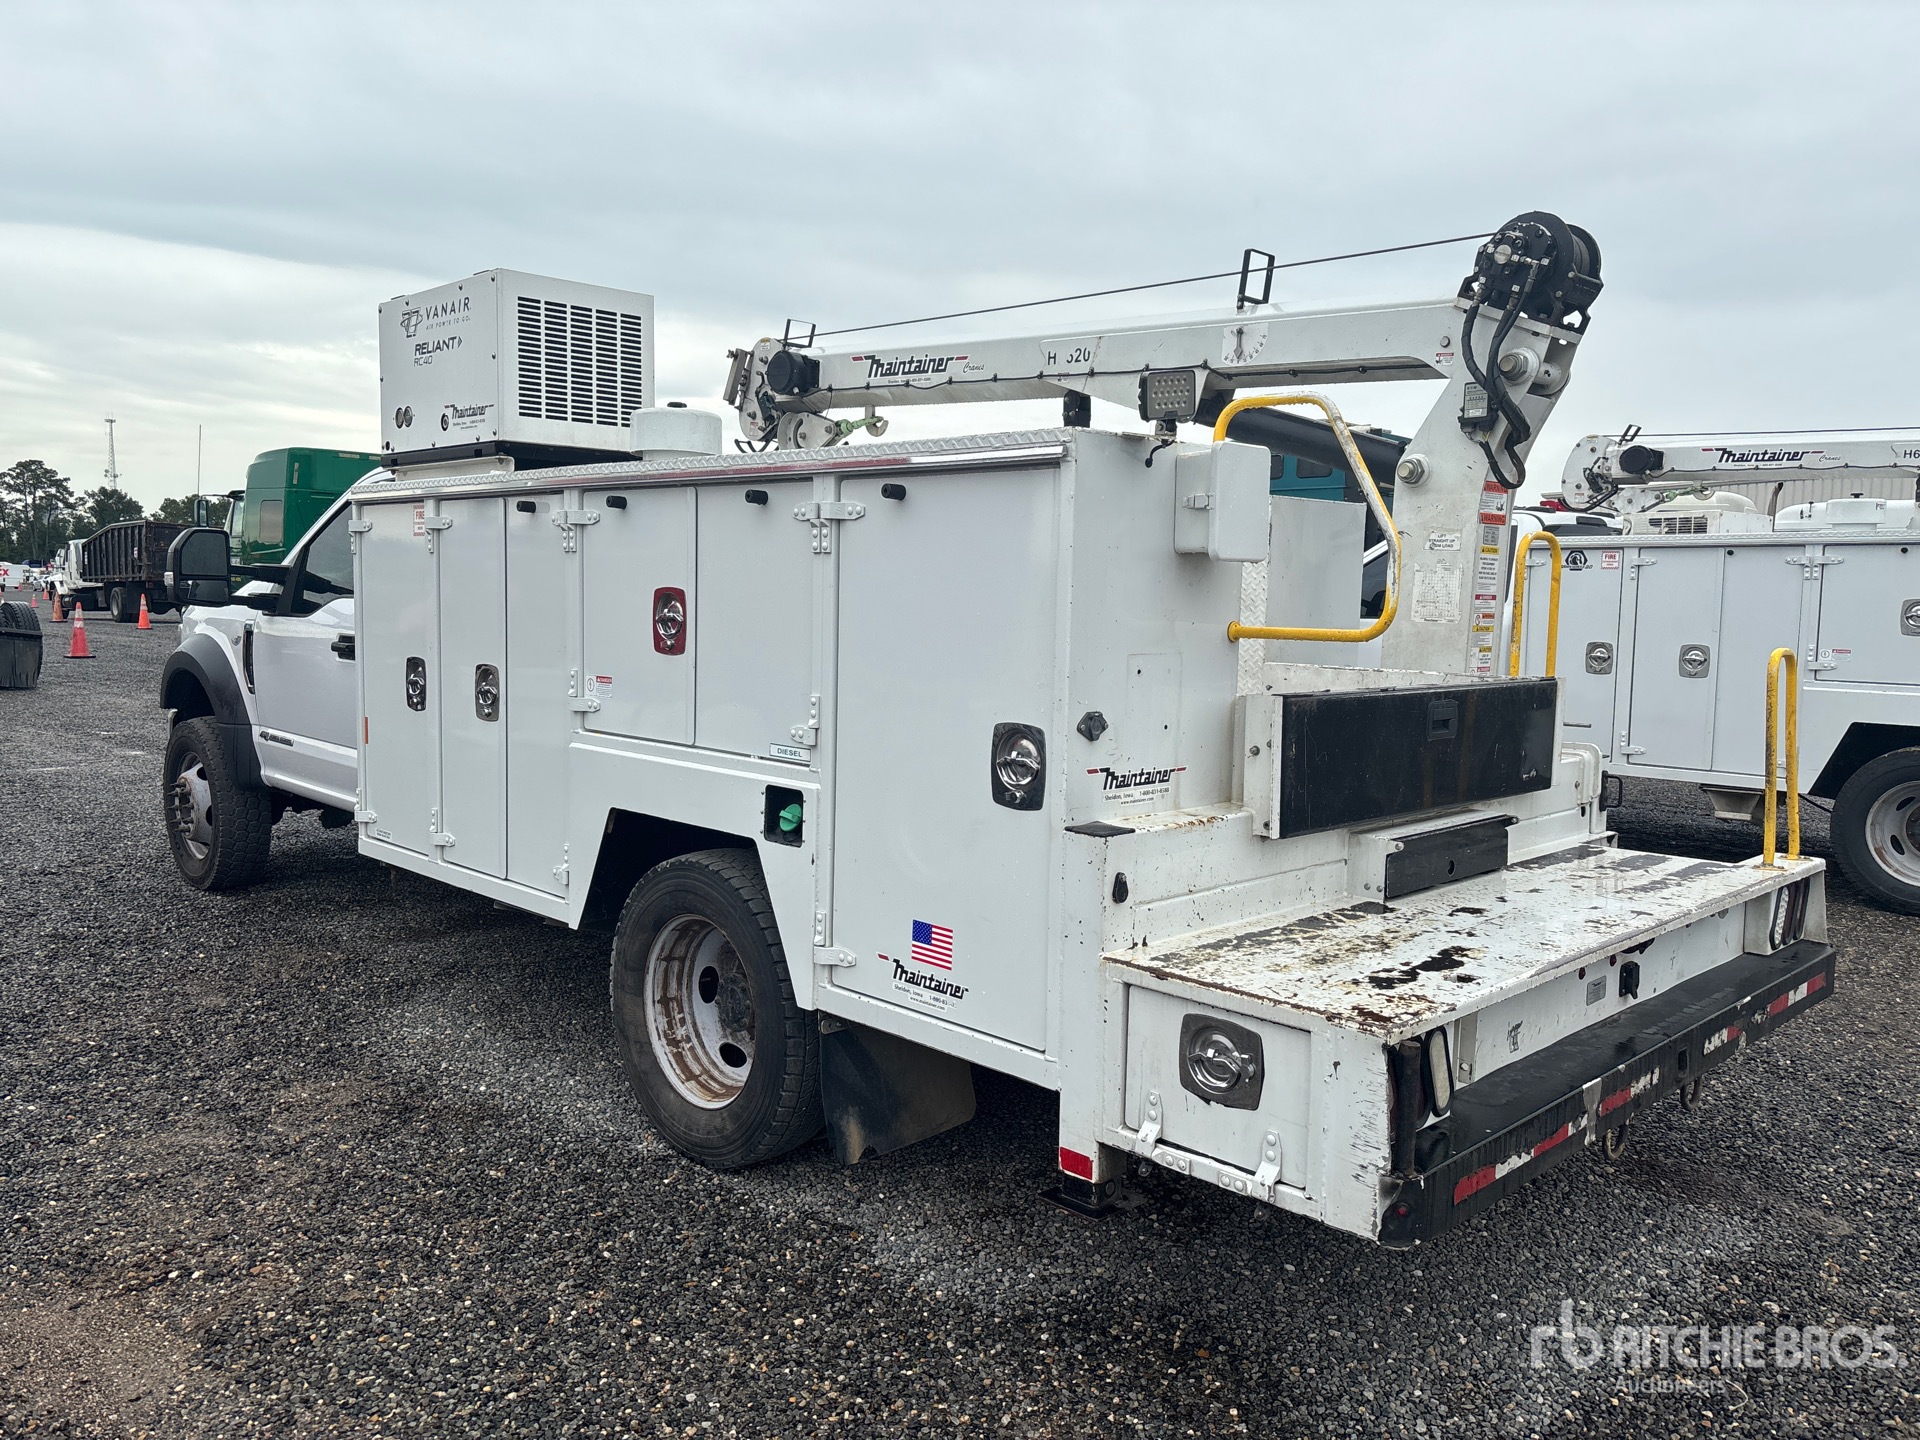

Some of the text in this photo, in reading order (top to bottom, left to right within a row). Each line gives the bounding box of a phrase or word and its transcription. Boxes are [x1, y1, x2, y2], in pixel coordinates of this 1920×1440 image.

[425, 296, 470, 321] VANAIR
[415, 336, 457, 357] RELIANT
[414, 355, 433, 368] RC40
[864, 354, 985, 378] Maintainer Cranes
[450, 403, 489, 420] Maintainer
[1713, 447, 1841, 464] Maintainer Cranes
[777, 747, 803, 758] DIESEL
[1099, 766, 1176, 791] Maintainer
[892, 958, 969, 1000] Maintainer
